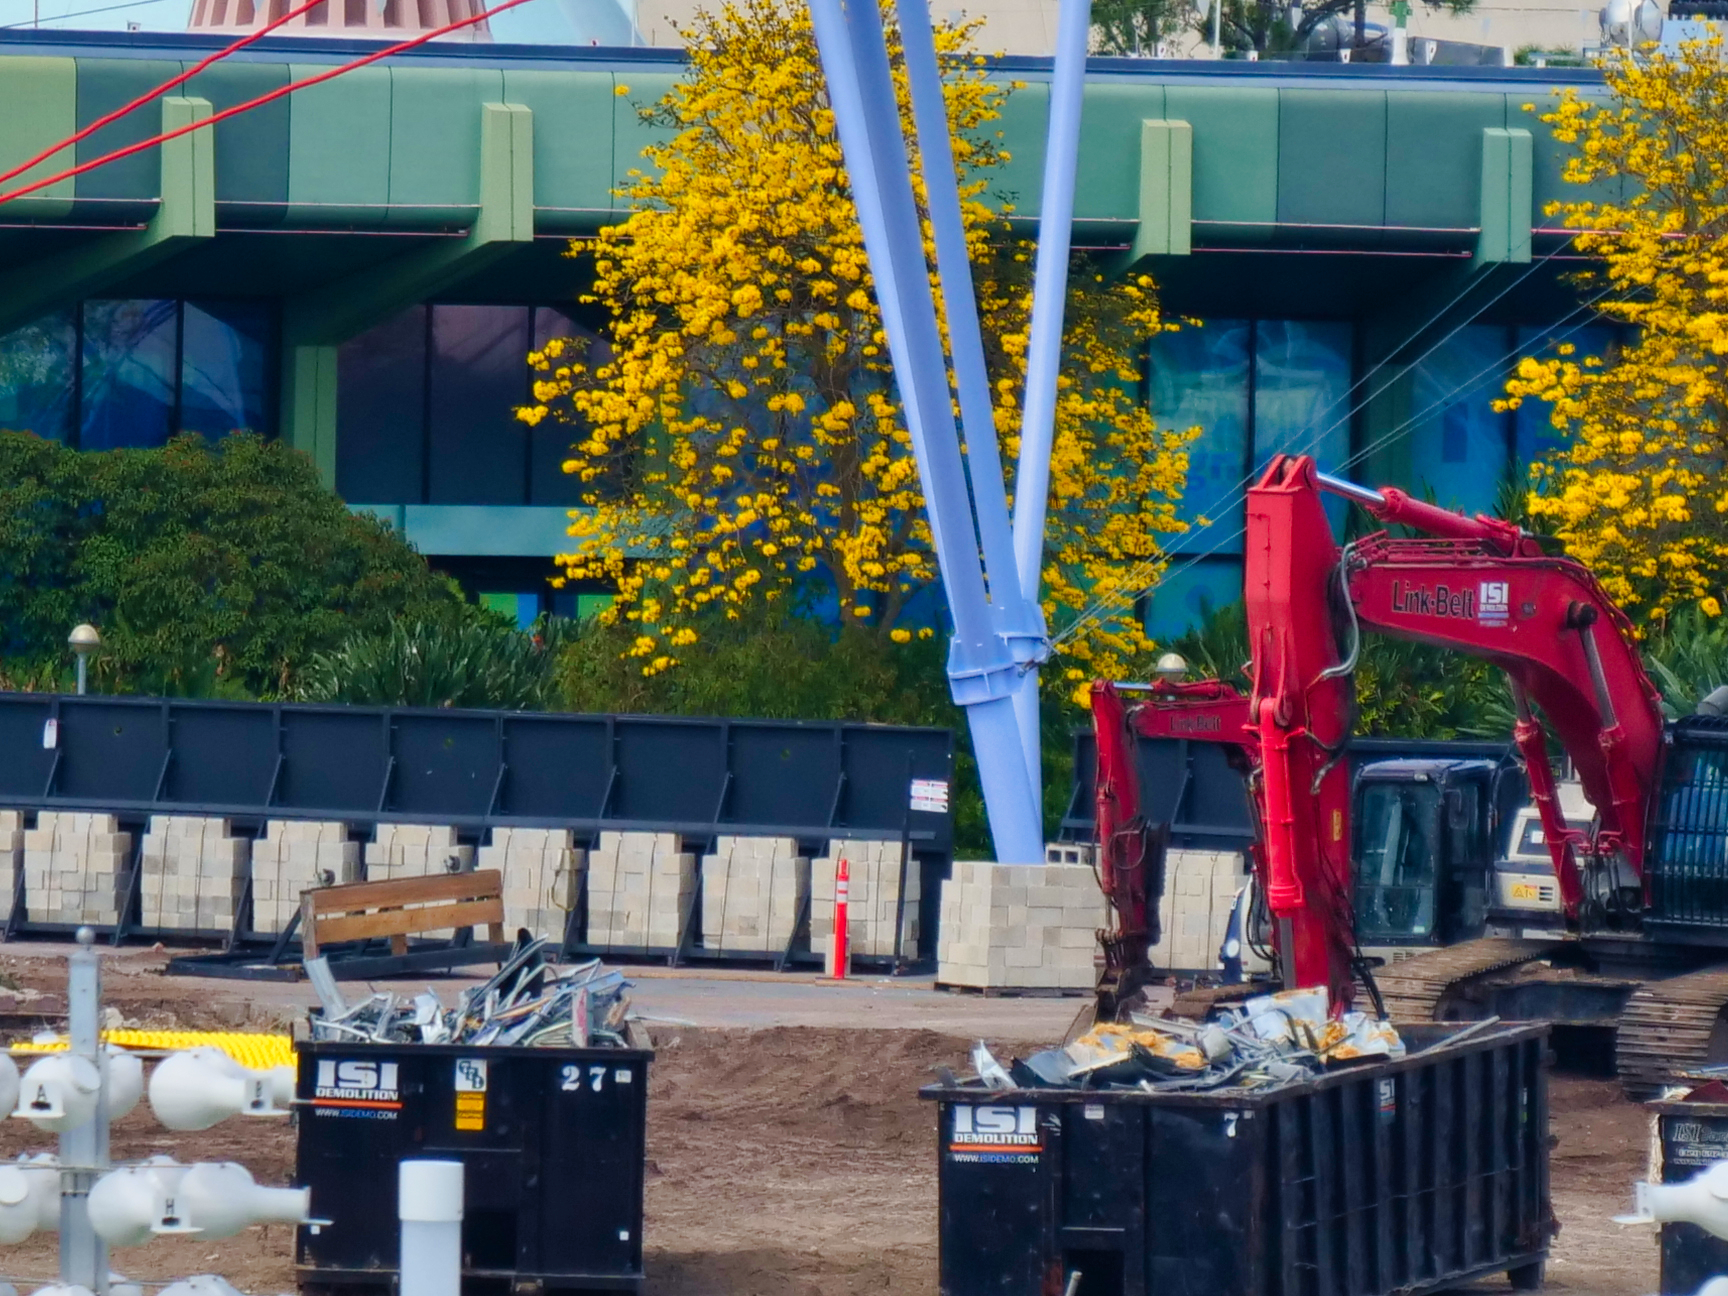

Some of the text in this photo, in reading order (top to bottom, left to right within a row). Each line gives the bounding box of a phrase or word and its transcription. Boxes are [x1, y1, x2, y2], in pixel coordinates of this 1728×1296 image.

[1480, 582, 1509, 604] ISI
[317, 1059, 398, 1090] ISI
[36, 1084, 47, 1101] A
[315, 1088, 399, 1101] DEMOLITION
[315, 1108, 398, 1120] WWW.ISIDEMO.COM
[955, 1106, 1037, 1133] ISI
[1224, 1112, 1239, 1138] 7
[1672, 1123, 1702, 1142] ISI
[954, 1133, 1039, 1145] DEMOLITION
[954, 1155, 1039, 1164] WWW.ISIDEMO.COM
[166, 1198, 174, 1215] H
